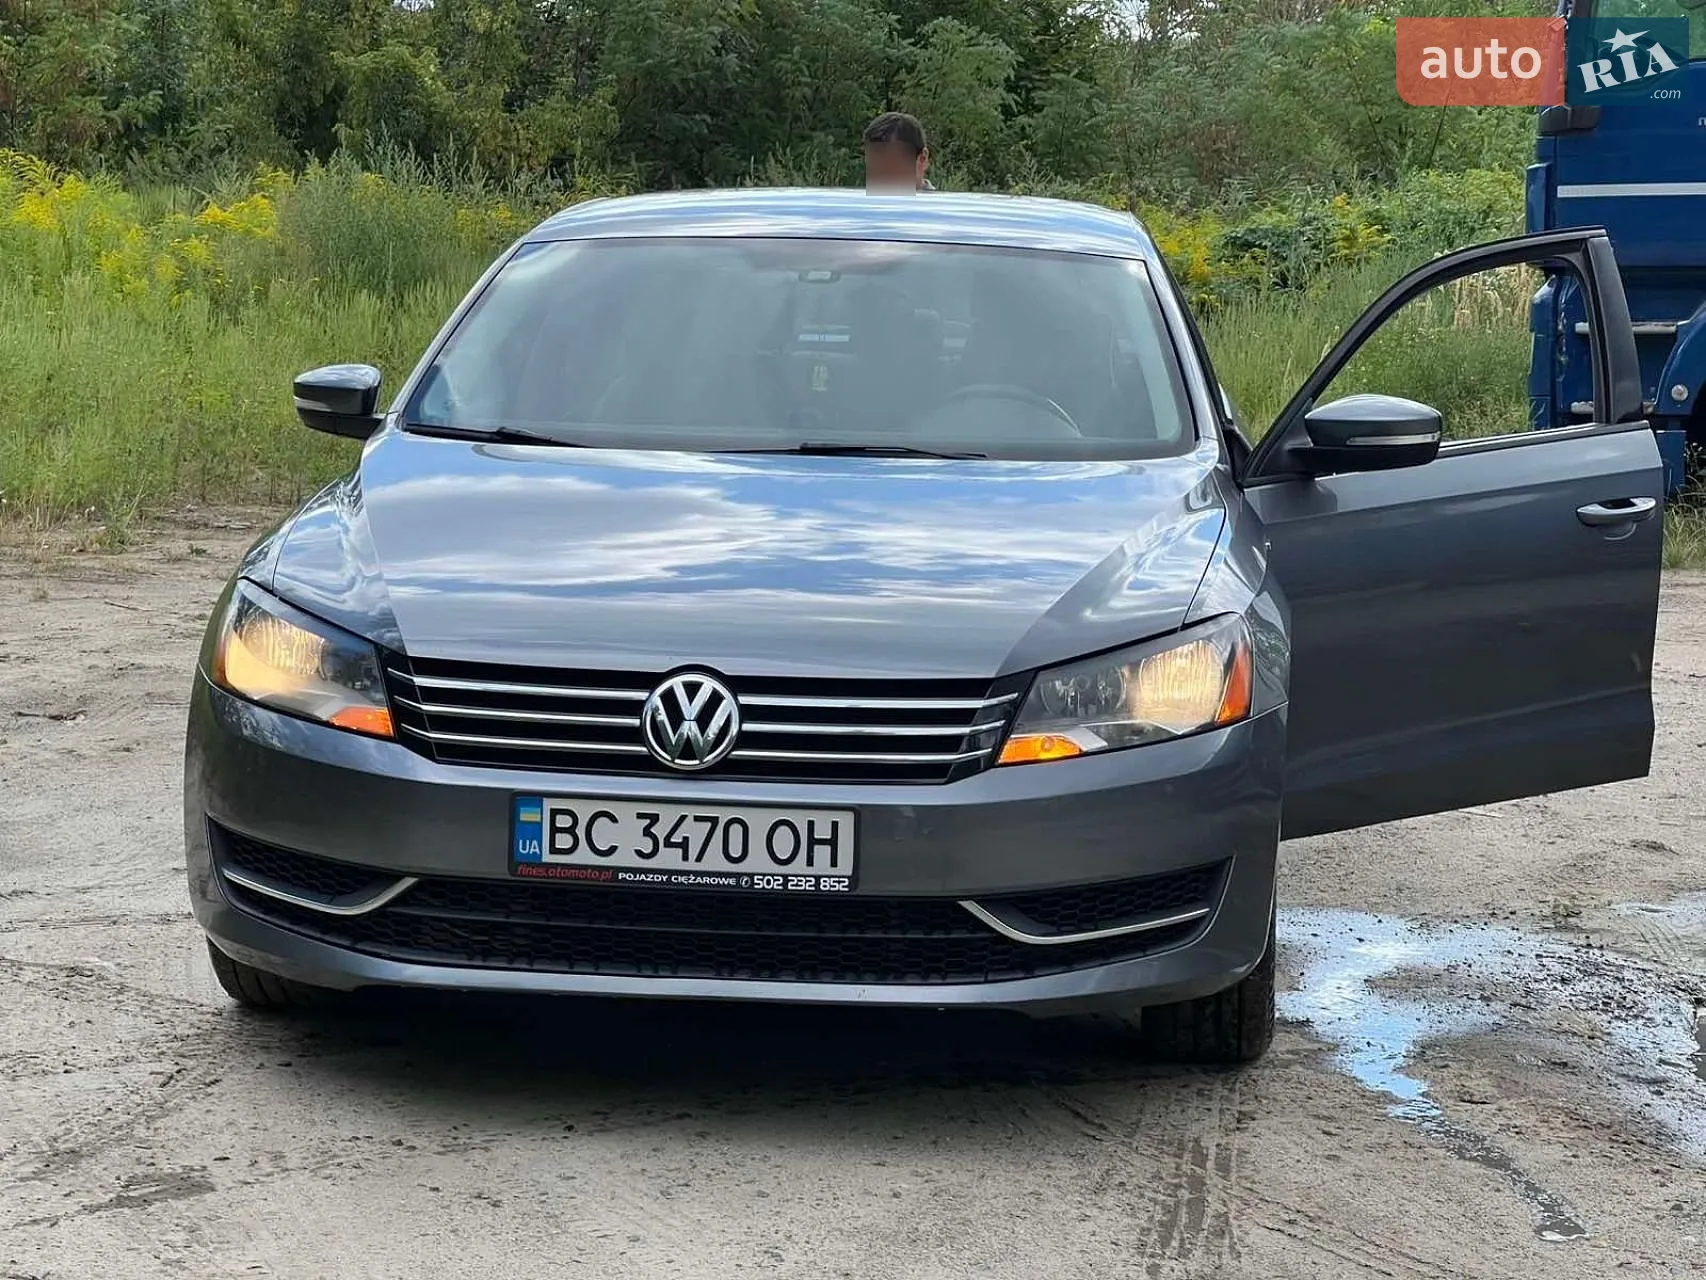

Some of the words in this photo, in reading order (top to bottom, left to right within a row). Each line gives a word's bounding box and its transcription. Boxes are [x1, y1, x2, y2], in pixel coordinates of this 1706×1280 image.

[519, 839, 540, 854] UA
[549, 807, 619, 857] BC
[634, 812, 749, 864] 3470
[766, 818, 839, 868] OH
[618, 872, 669, 883] POJAZDY
[671, 874, 736, 886] CIĘŻAROWE
[753, 875, 783, 889] 502
[787, 876, 816, 890] 232
[819, 877, 849, 891] 852
